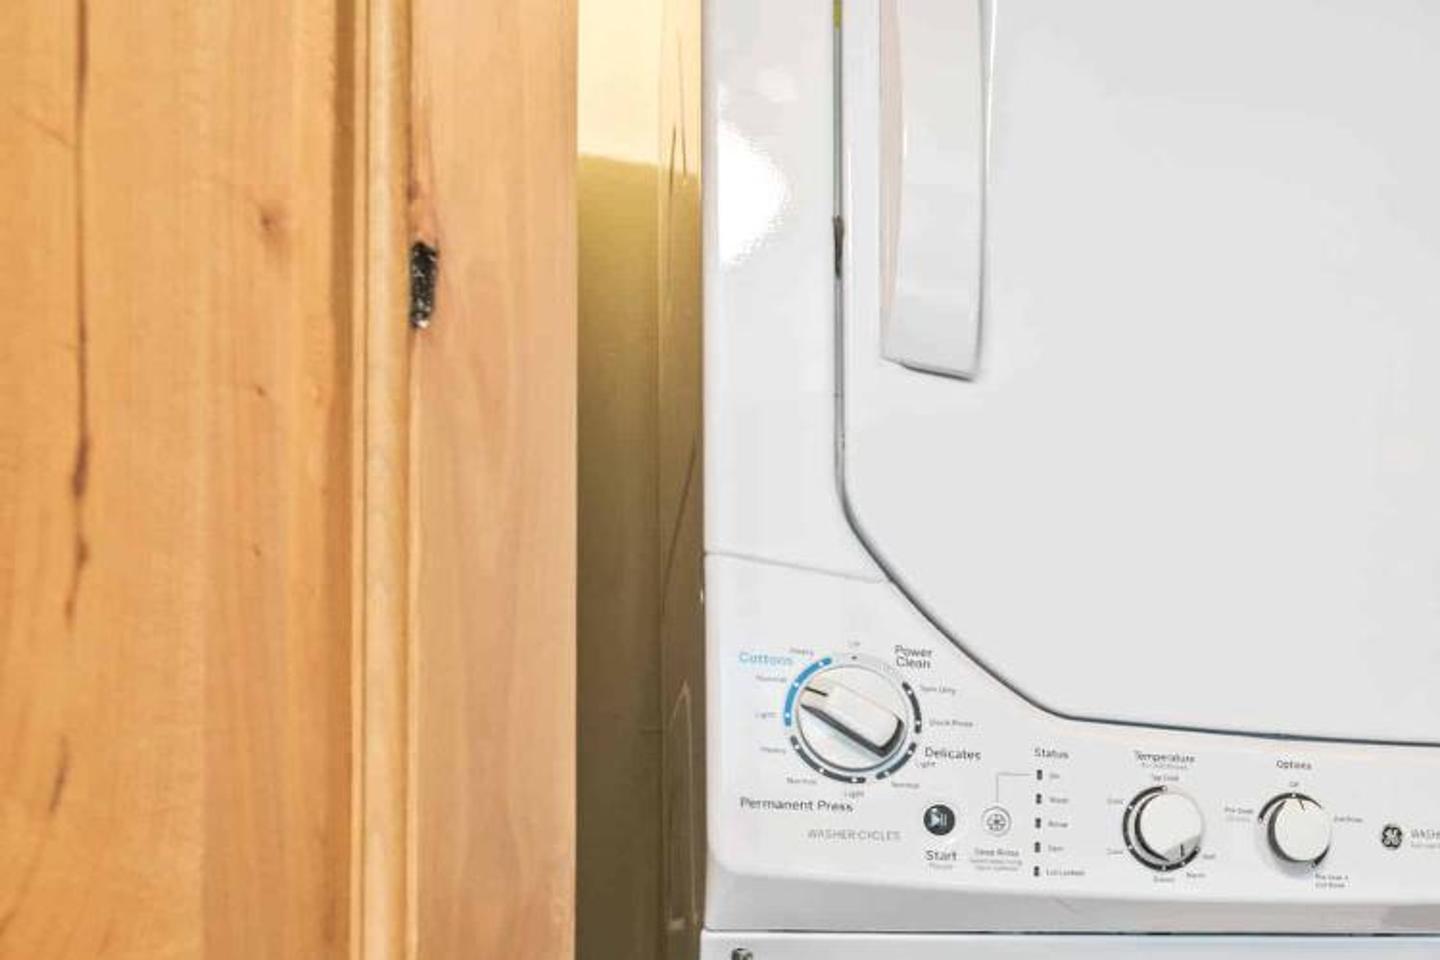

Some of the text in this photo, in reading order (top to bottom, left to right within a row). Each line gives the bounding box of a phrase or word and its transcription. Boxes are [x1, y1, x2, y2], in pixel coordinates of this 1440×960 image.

[895, 645, 932, 657] Power
[738, 652, 793, 665] Cottons
[896, 657, 930, 669] Clean
[925, 747, 981, 761] Delicates
[1034, 748, 1069, 759] Status
[1134, 750, 1195, 763] Temperature
[1276, 760, 1312, 770] Options
[740, 797, 853, 813] Permanent Press
[808, 830, 855, 840] WASHER
[926, 850, 957, 861] Start
